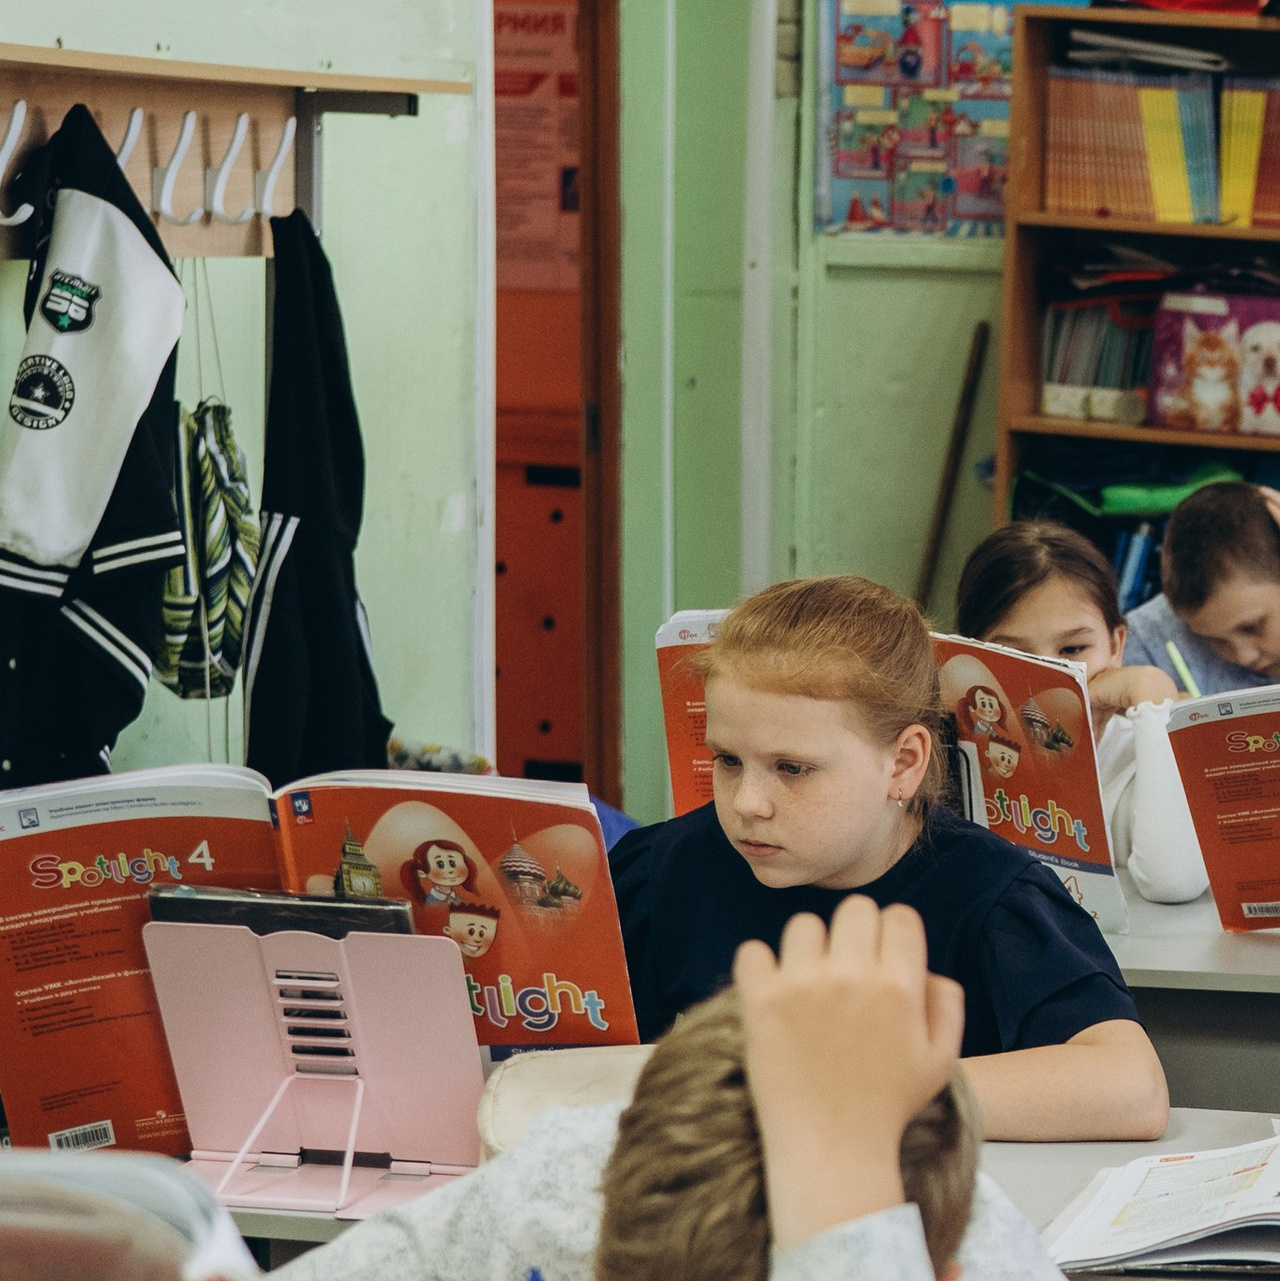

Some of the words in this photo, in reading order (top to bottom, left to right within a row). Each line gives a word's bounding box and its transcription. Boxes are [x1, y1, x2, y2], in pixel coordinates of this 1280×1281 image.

[11, 405, 58, 429] DESIGN
[984, 788, 1091, 852] otlight
[29, 848, 183, 890] Spotlight
[187, 839, 216, 871] 4
[44, 981, 63, 991] УМК
[465, 973, 610, 1032] tlight
